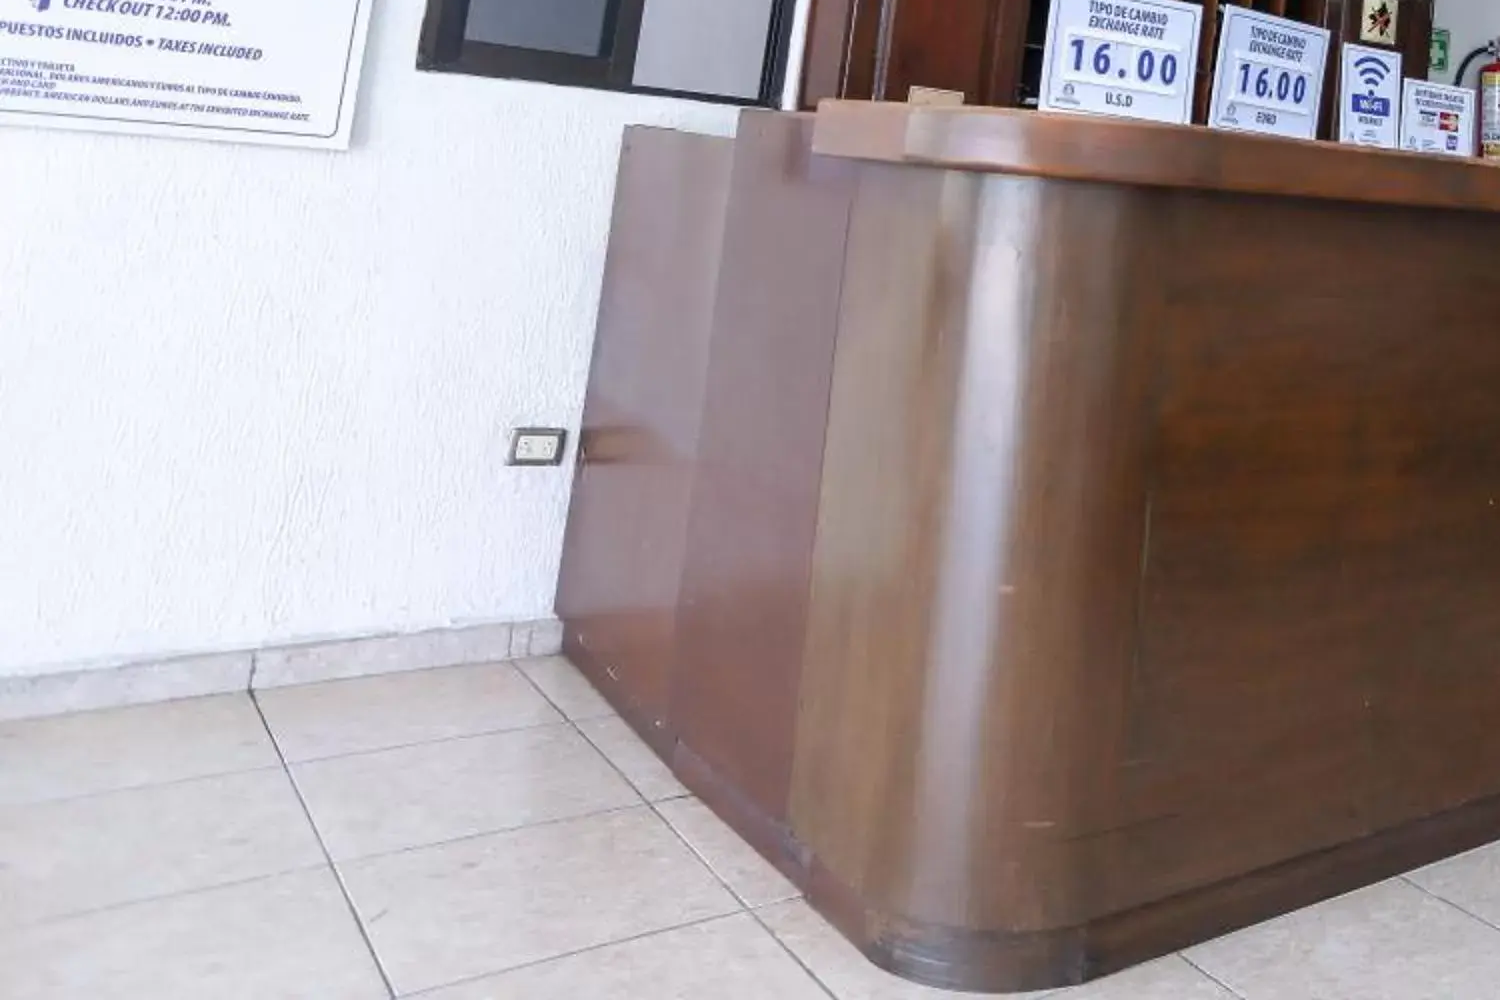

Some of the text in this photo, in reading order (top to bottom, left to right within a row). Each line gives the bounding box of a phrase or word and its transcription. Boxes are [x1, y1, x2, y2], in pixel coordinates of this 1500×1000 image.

[119, 1, 155, 17] OUT
[155, 4, 201, 23] 12:00
[201, 10, 232, 27] PM.
[1088, 0, 1169, 26] TIPO DE CAMBIO
[1088, 15, 1166, 41] EXCHANGE RATE
[1251, 25, 1307, 49] TIPO DE CAMBIO
[66, 27, 144, 48] INCLUIDOS
[157, 37, 196, 54] TAXES
[197, 42, 263, 61] INCLUDED
[1249, 40, 1286, 59] EXCHANGE
[1070, 39, 1177, 86] 16.00
[1240, 63, 1306, 104] 16.00
